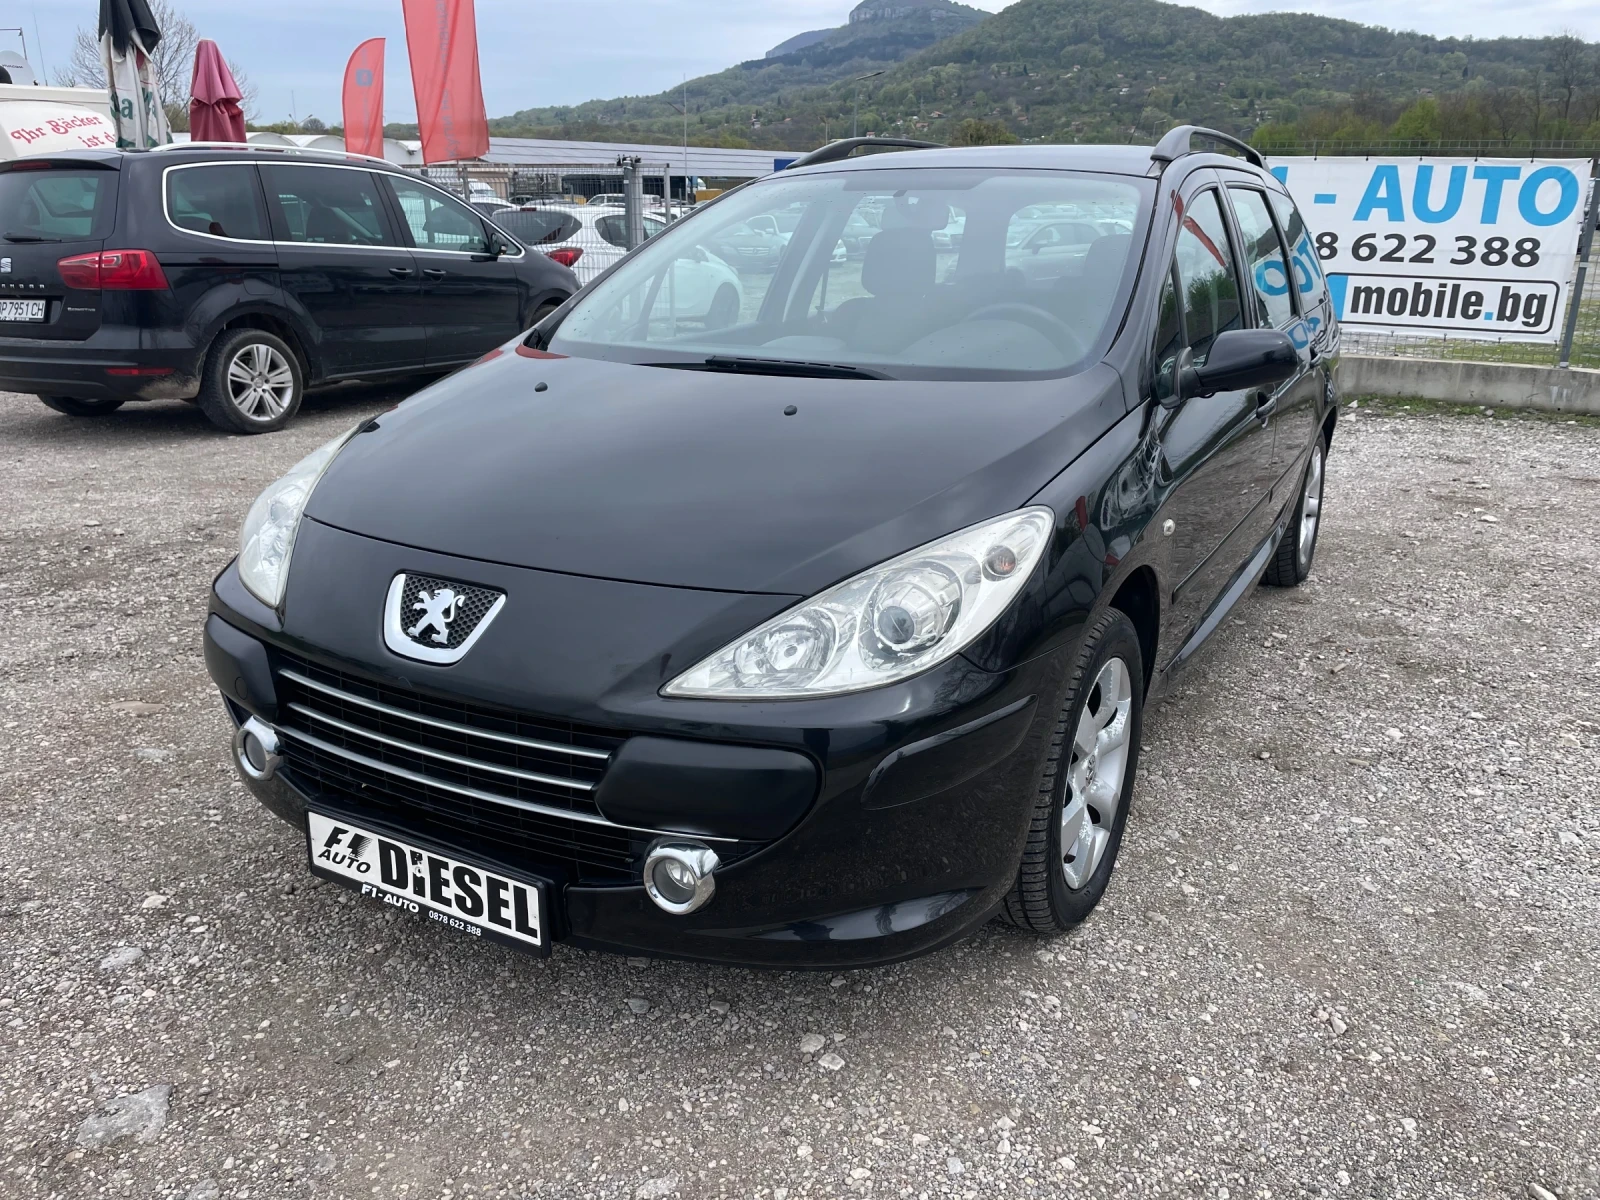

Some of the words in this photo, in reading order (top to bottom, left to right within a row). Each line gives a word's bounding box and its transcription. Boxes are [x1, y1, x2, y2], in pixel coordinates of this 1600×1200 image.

[11, 127, 46, 144] Ihr
[46, 116, 103, 134] Bäcker
[78, 135, 105, 148] ist
[104, 132, 116, 143] d
[1352, 164, 1580, 227] AUTO
[1351, 232, 1437, 264] 622
[1450, 235, 1541, 268] 388
[8, 301, 30, 317] 7951
[1350, 281, 1548, 328] mobile.bg
[318, 849, 371, 874] AUTO
[361, 883, 420, 913] F1-AUTO
[378, 838, 538, 939] DIESEL
[428, 910, 448, 925] 0878
[449, 917, 465, 932] 622
[466, 922, 482, 937] 388
